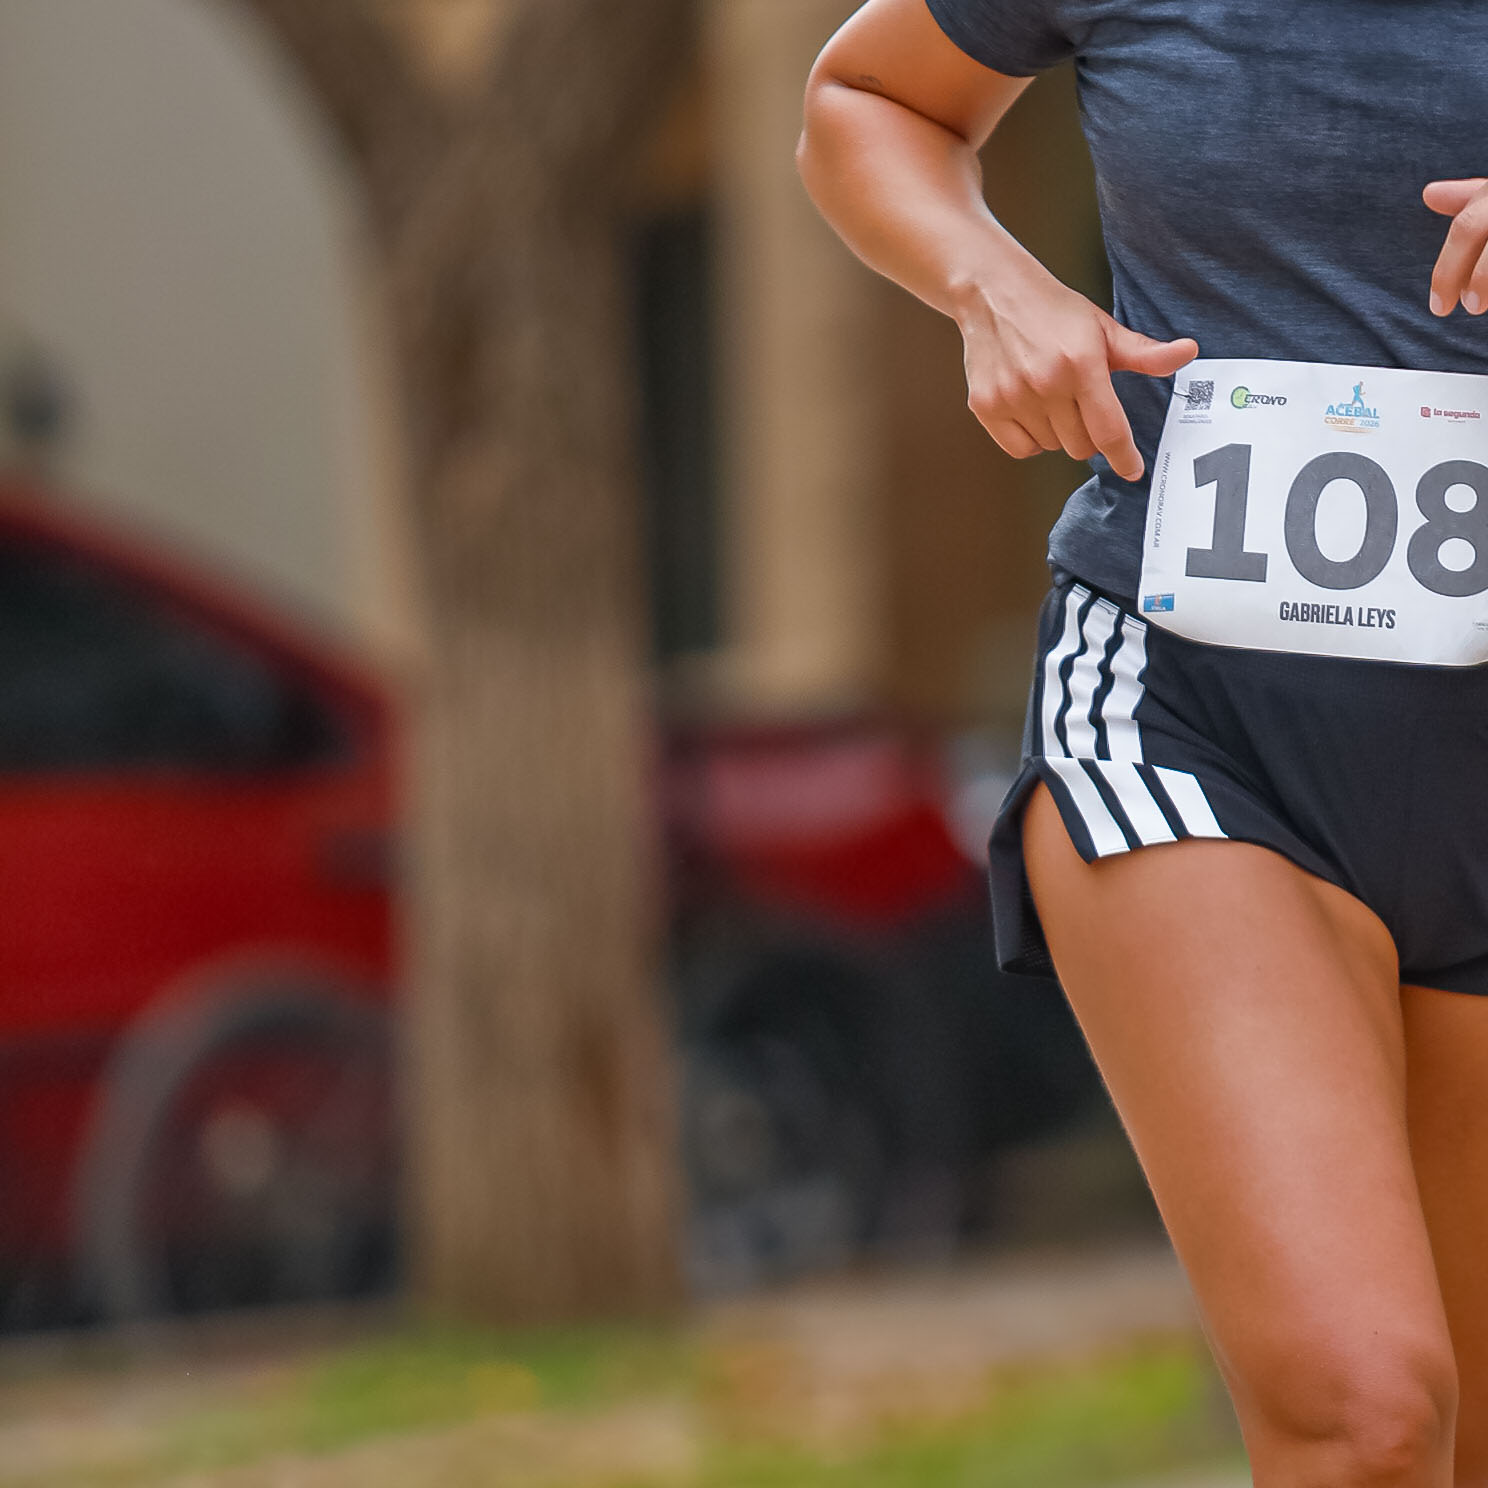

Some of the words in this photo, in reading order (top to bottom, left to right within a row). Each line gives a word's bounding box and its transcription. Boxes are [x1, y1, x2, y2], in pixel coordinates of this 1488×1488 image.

[1325, 403, 1380, 419] ACEBAL
[1433, 408, 1443, 416] la
[1443, 409, 1481, 419] segunda
[1279, 601, 1354, 626] GABRIELA
[1358, 606, 1396, 629] LEYS
